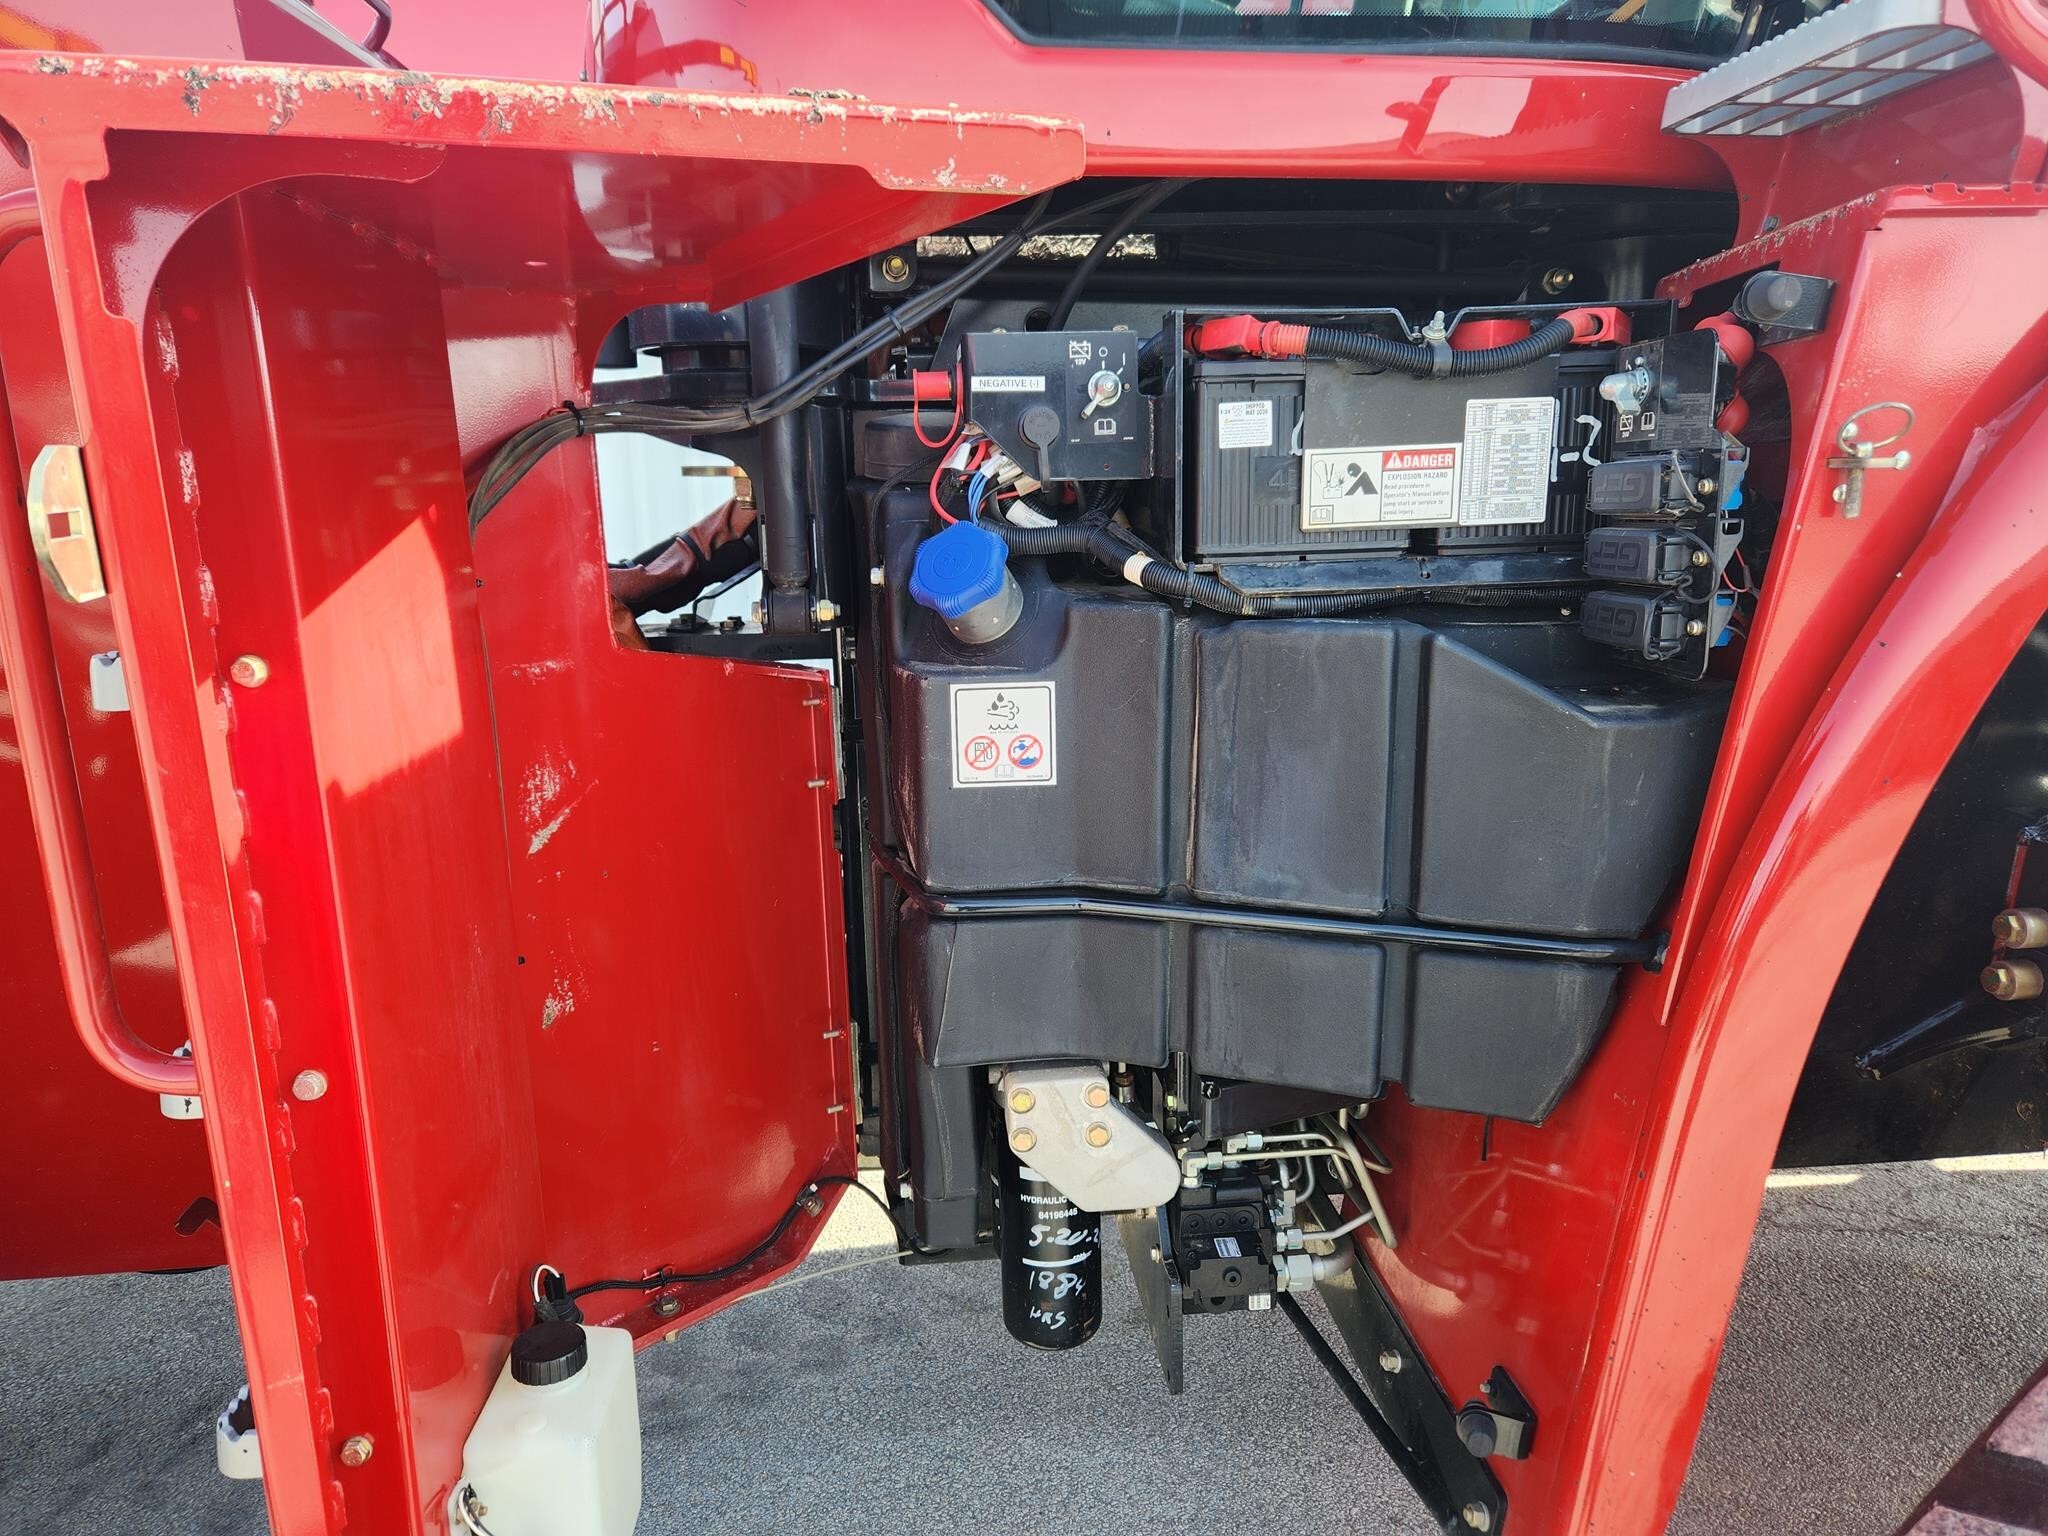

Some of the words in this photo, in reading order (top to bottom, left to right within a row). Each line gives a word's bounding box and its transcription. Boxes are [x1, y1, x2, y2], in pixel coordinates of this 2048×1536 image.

[1075, 358, 1087, 366] 12V
[979, 378, 1027, 388] NEGATIVE
[1403, 453, 1454, 468] DANGER
[1387, 472, 1422, 481] EXPLOSION
[1423, 471, 1448, 480] HAZARD
[1398, 482, 1424, 490] procedure
[1384, 490, 1411, 498] Operator's
[1020, 1193, 1068, 1205] HYDRAULIC
[1038, 1207, 1078, 1220] 84196445
[1029, 1270, 1087, 1300] 1884
